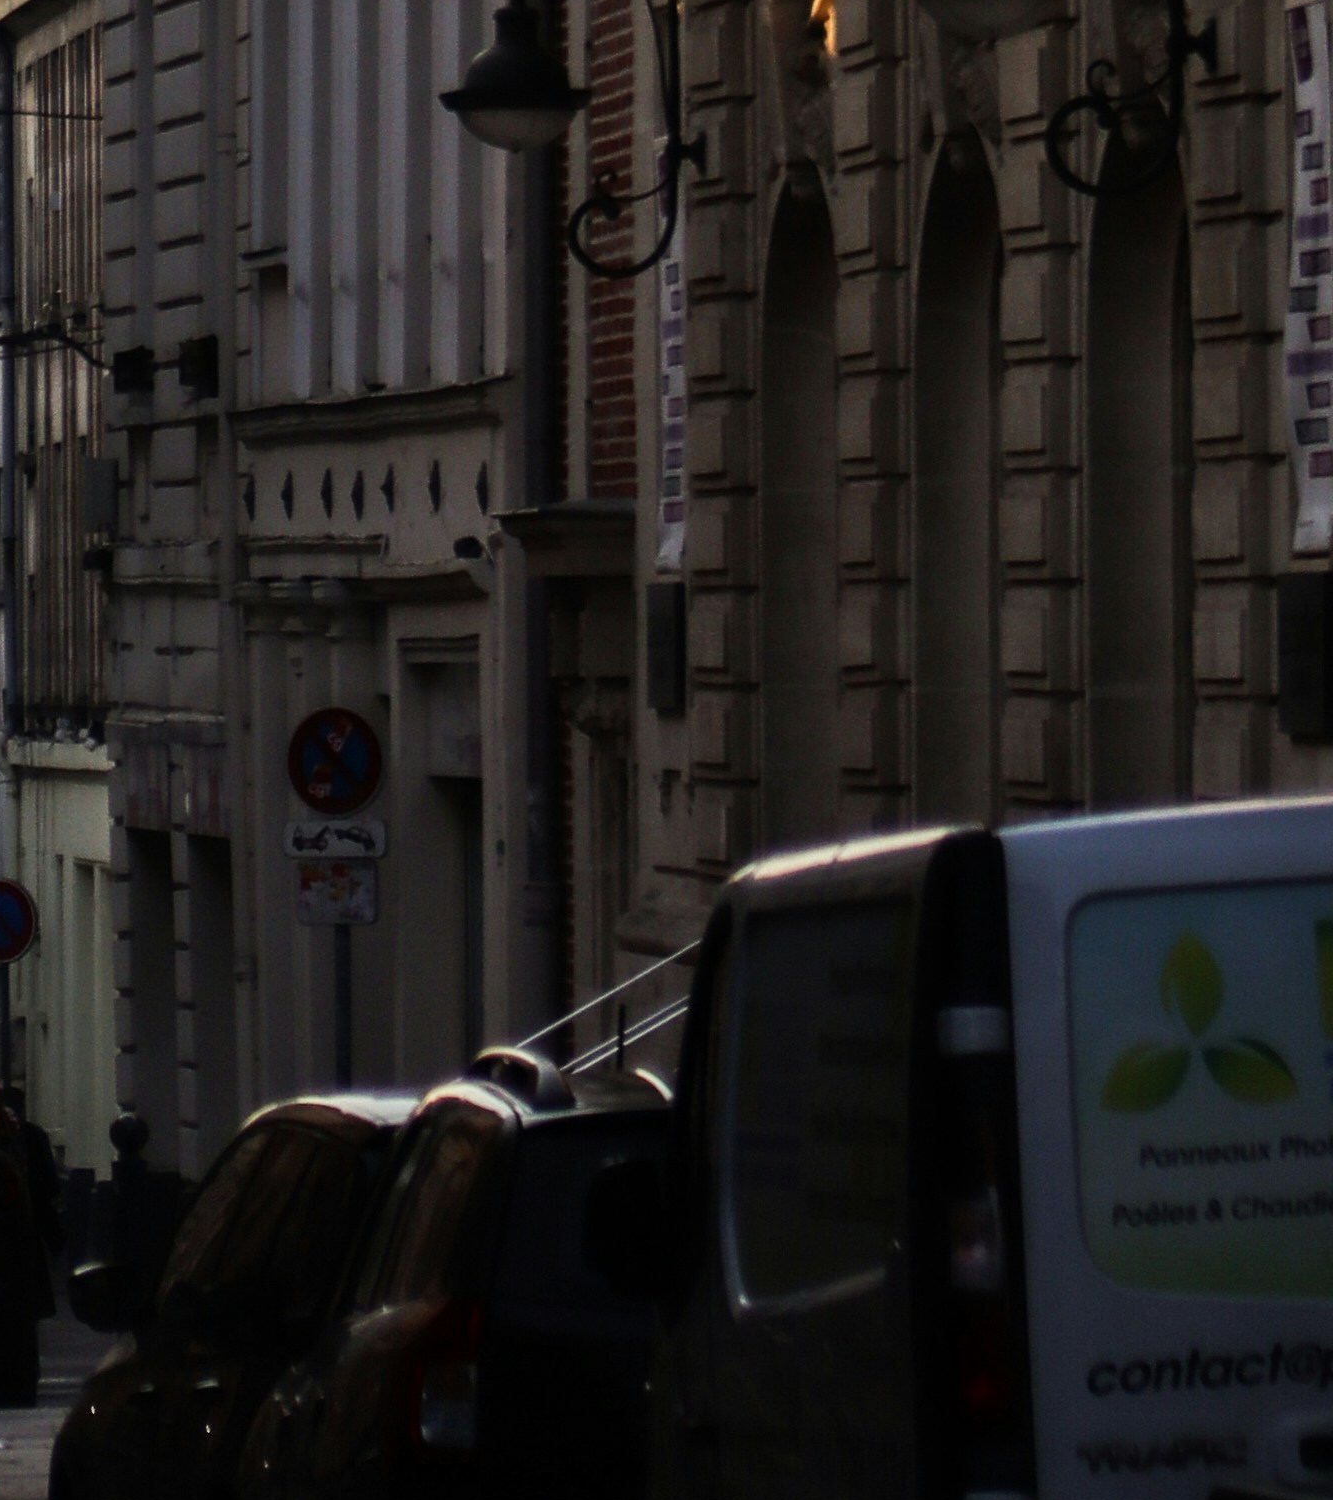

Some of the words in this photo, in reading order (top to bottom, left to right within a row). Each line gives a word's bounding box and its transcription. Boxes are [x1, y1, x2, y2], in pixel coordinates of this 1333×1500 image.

[1139, 1142, 1271, 1169] Panneaux
[1112, 1202, 1197, 1228] Poêles
[1205, 1199, 1223, 1222] &
